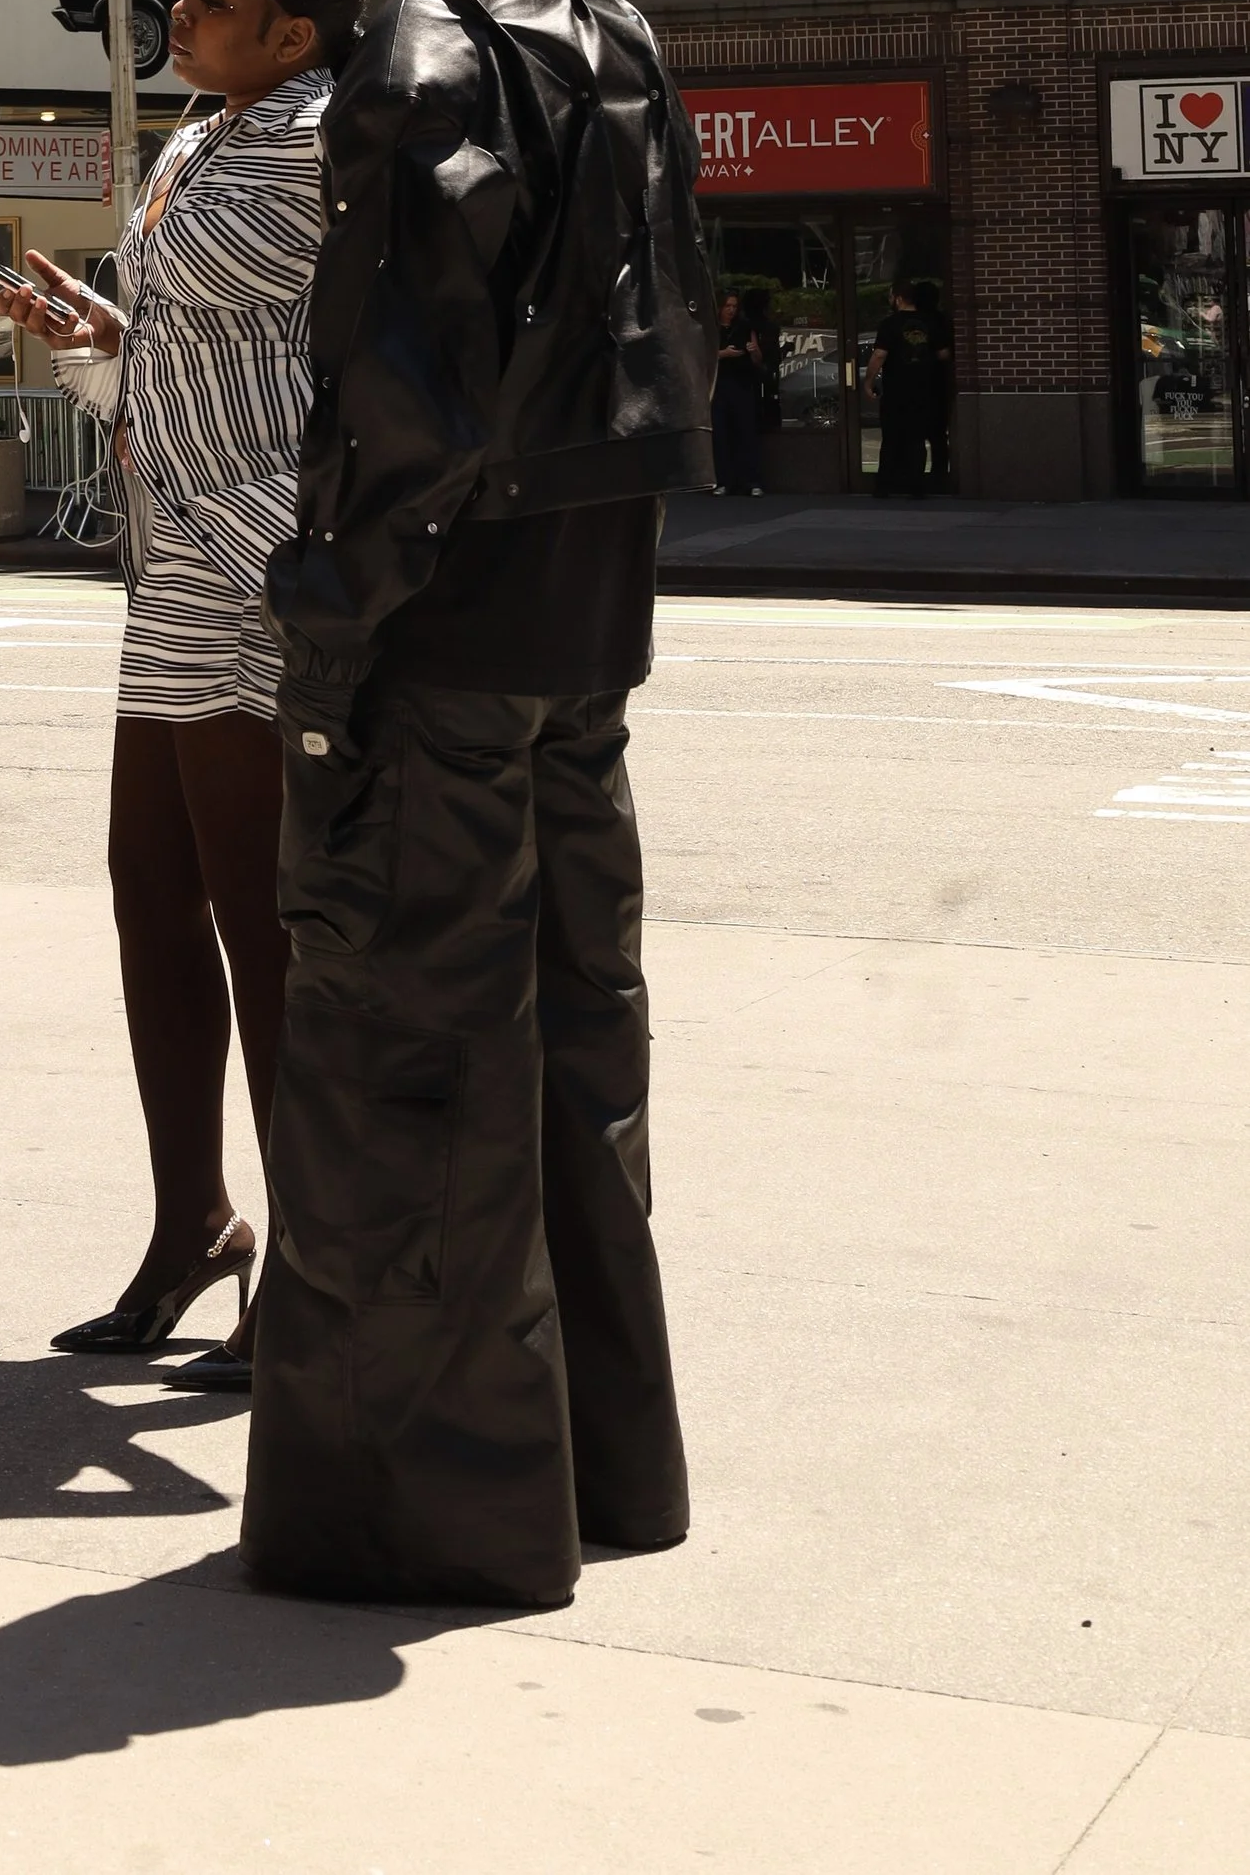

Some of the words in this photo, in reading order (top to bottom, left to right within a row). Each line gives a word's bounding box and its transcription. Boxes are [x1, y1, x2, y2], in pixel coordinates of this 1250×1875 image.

[1155, 94, 1176, 129] I
[1153, 132, 1228, 164] NY
[32, 160, 101, 183] YEAR
